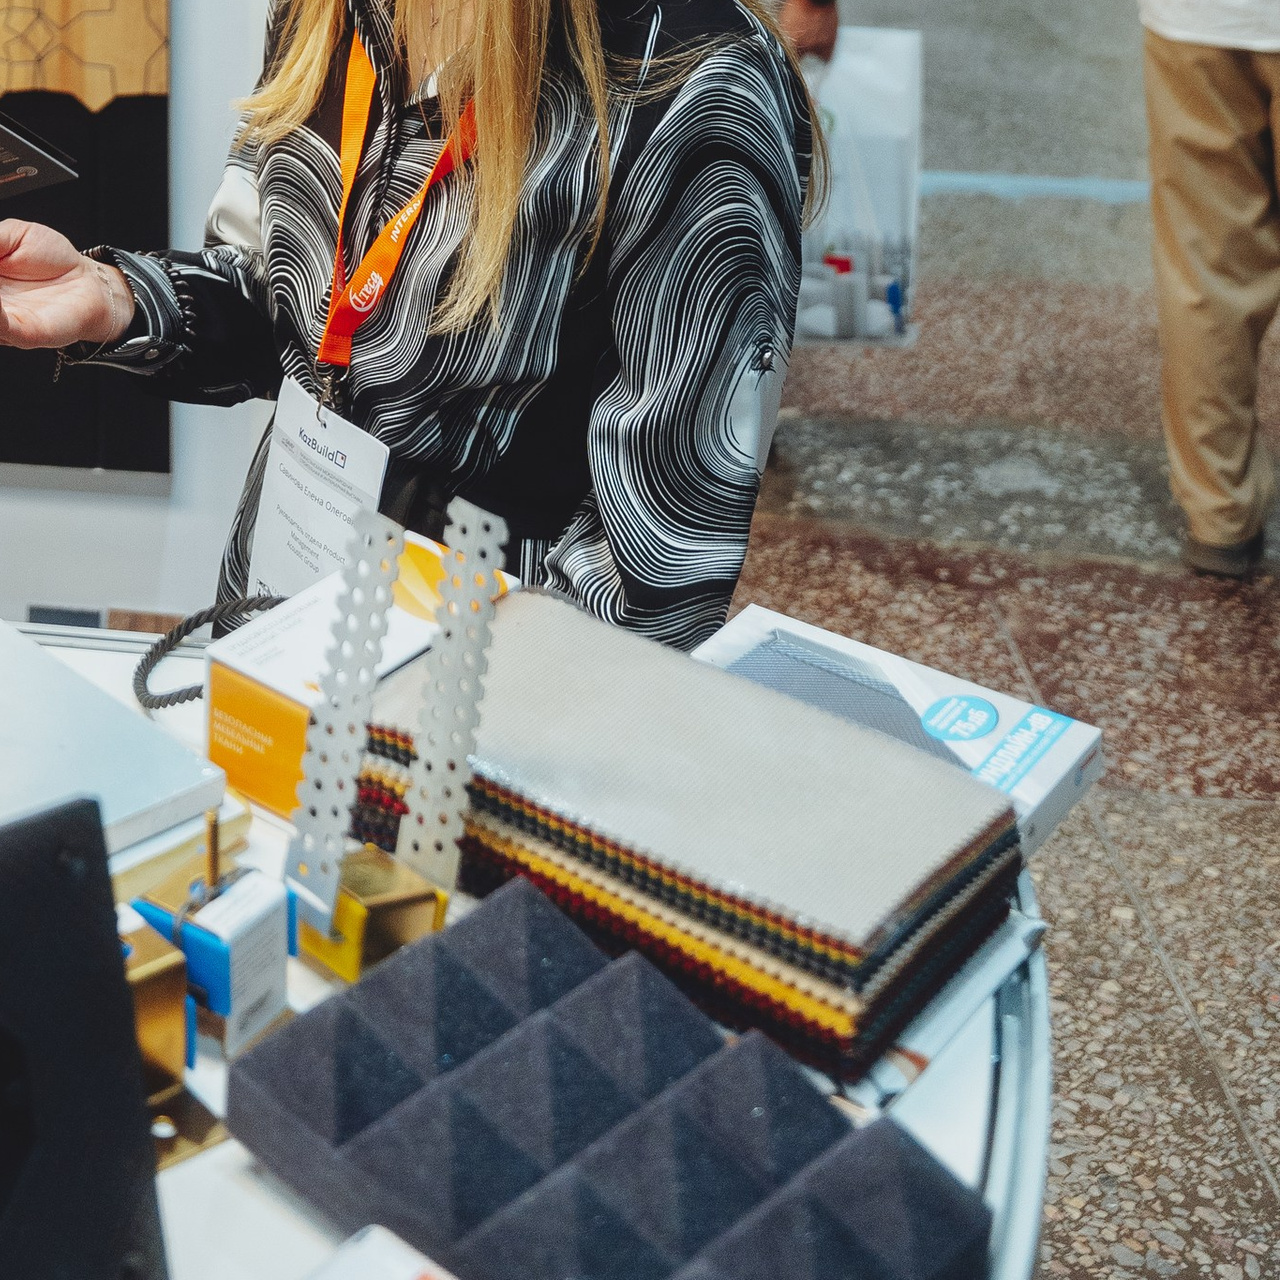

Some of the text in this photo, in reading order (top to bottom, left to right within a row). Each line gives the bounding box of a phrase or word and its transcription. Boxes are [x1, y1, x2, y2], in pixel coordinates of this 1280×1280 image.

[298, 427, 335, 462] KazBuild
[279, 462, 304, 492] Савинова
[304, 486, 324, 506] Елена
[303, 556, 320, 574] Group
[323, 544, 346, 566] Product
